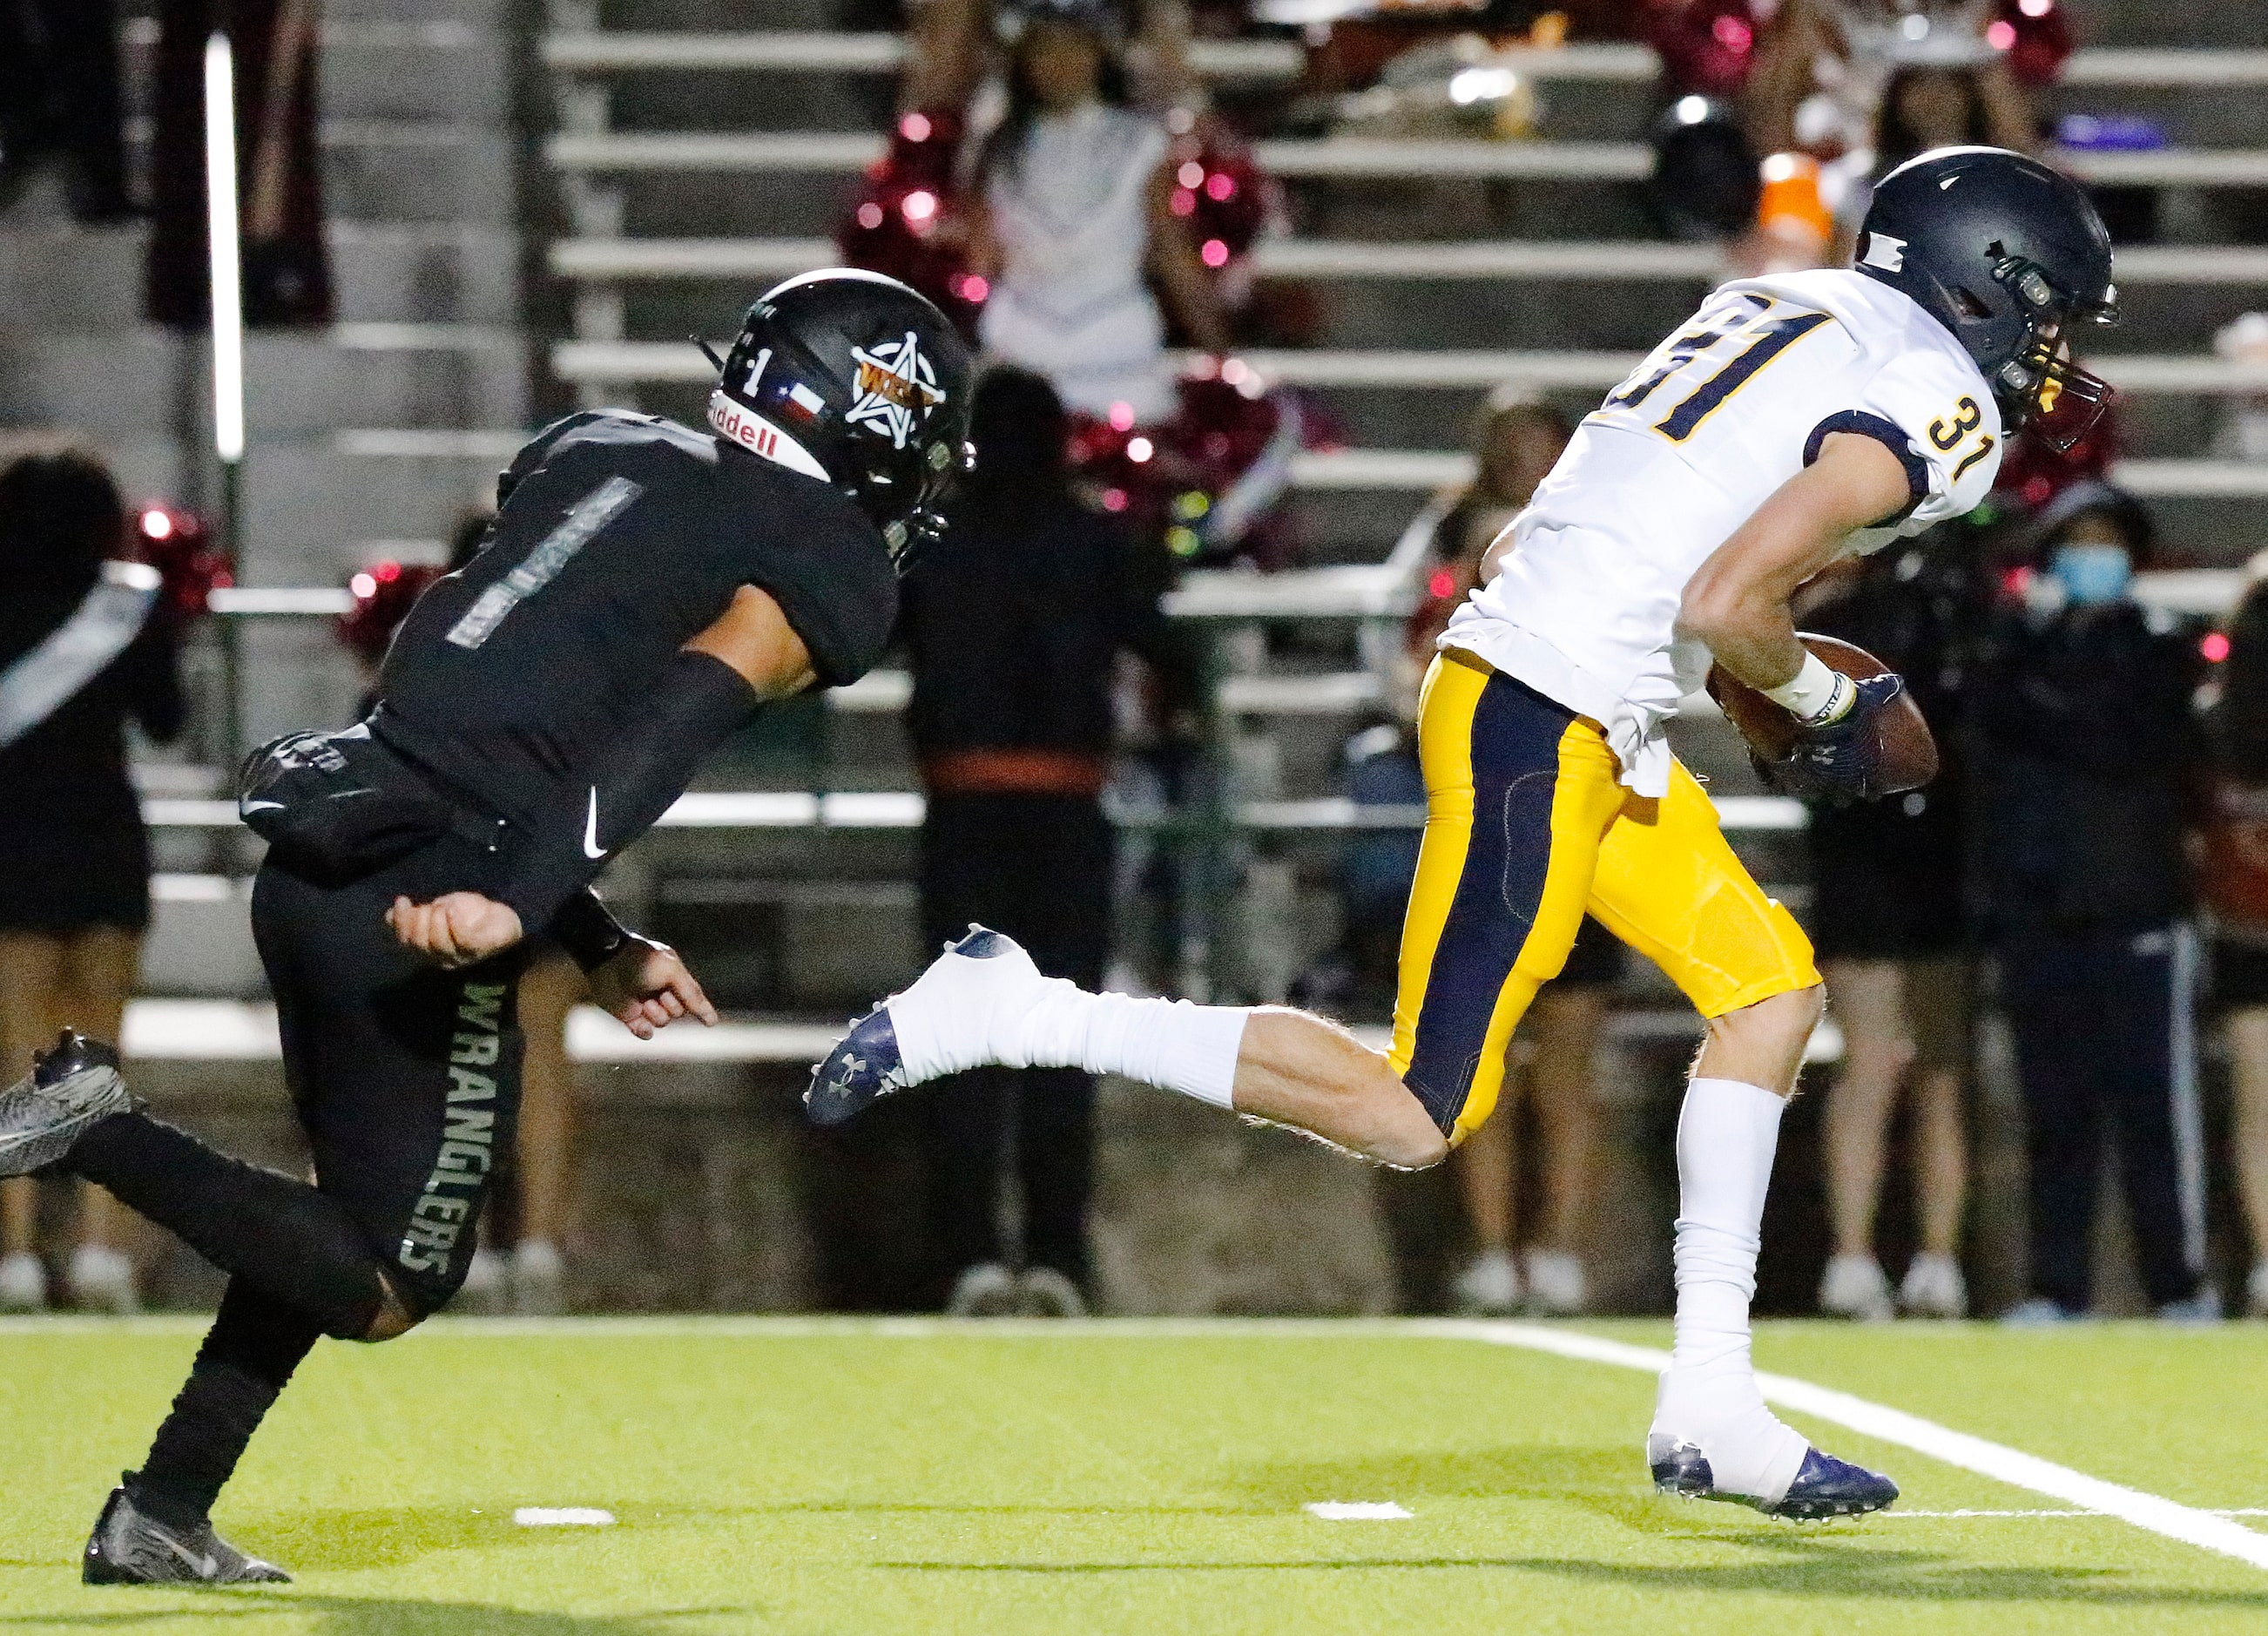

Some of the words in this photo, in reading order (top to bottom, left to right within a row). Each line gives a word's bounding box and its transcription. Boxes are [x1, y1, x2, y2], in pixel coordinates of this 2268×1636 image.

[708, 406, 777, 457] iddell
[1927, 395, 1997, 486] 31
[444, 476, 646, 650] 1
[398, 984, 508, 1276] WRANGLERS
